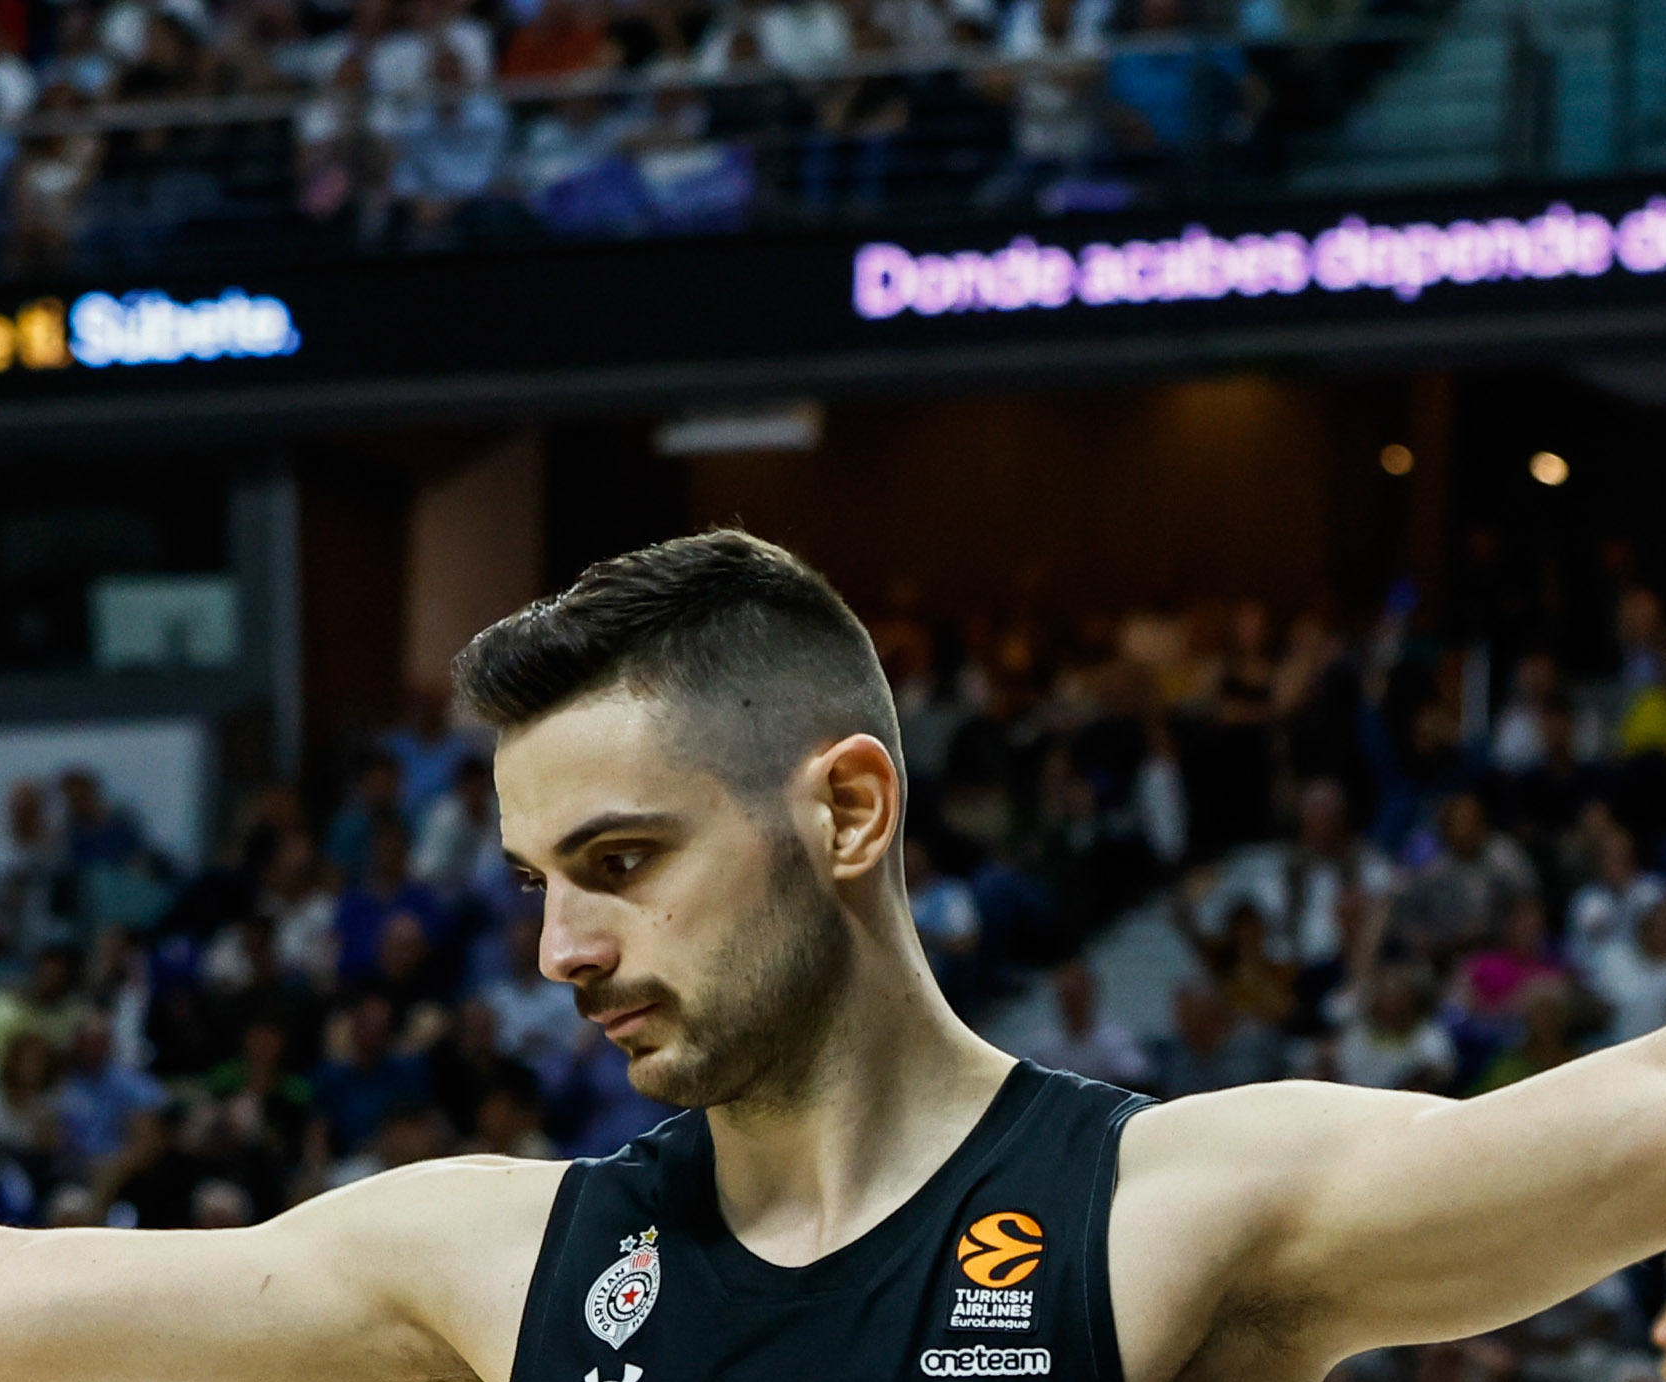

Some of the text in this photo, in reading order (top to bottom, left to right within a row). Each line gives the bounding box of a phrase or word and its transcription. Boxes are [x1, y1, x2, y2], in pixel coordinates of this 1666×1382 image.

[853, 235, 1075, 318] Donde
[1078, 224, 1311, 304] acabes
[1310, 203, 1614, 302] depende
[955, 1288, 1034, 1304] TURKISH
[952, 1302, 1032, 1318] AIRLINES
[950, 1316, 1031, 1329] EuroLeague
[923, 1346, 1049, 1375] oneteam
